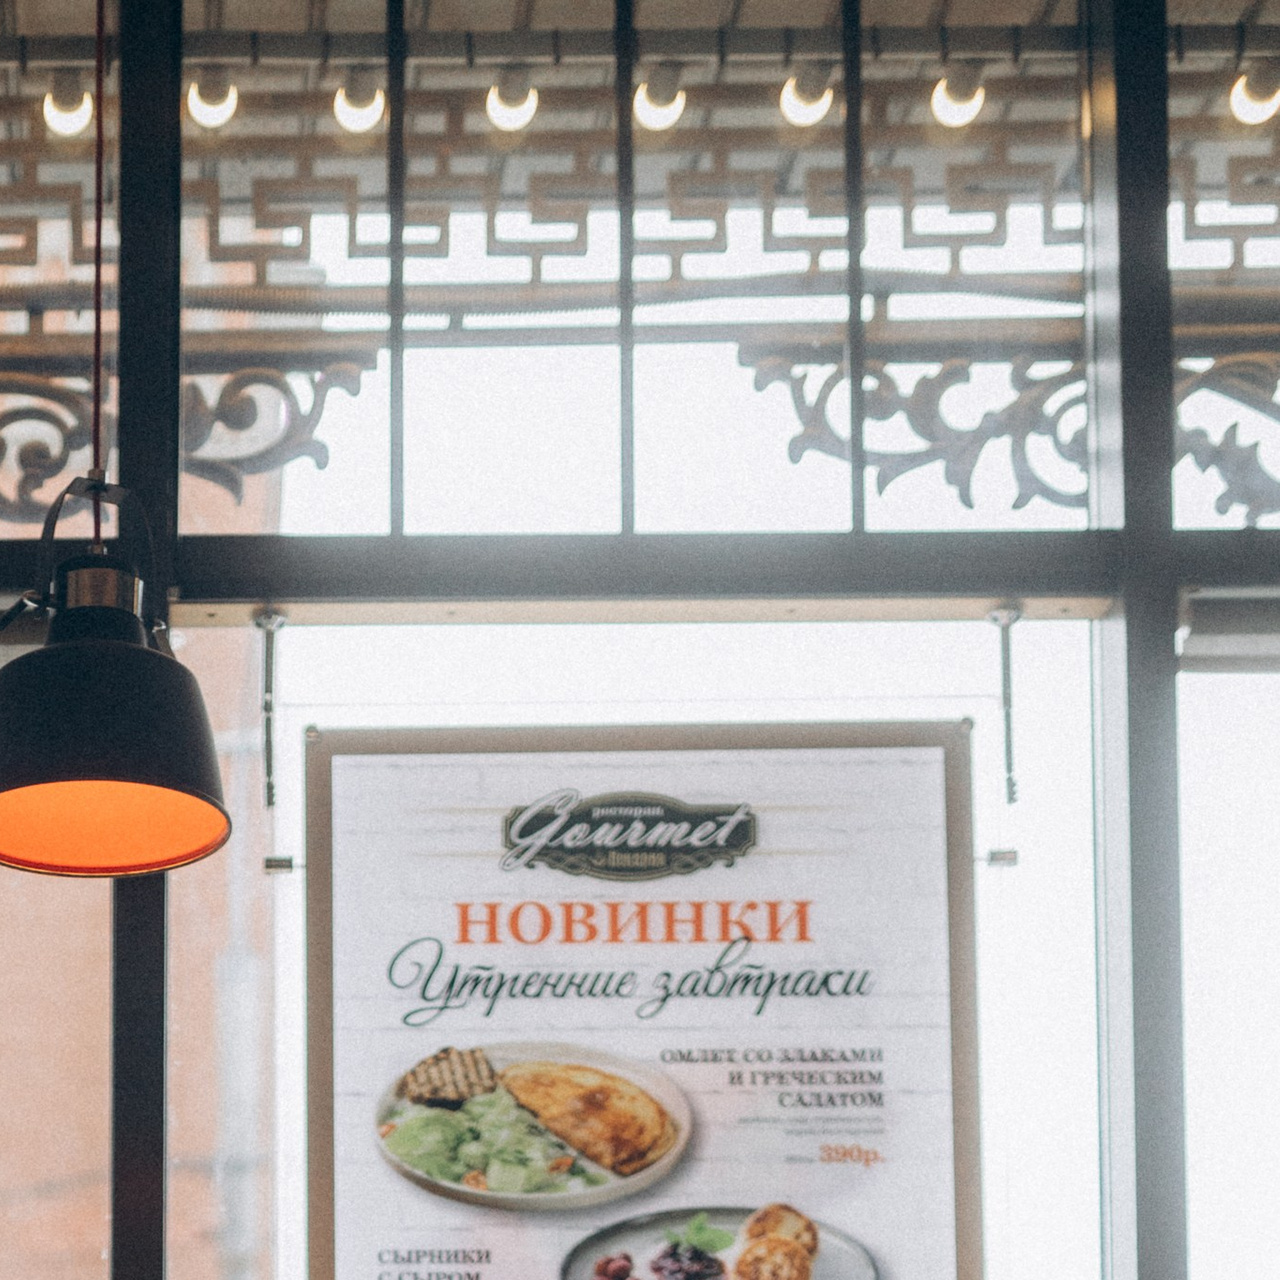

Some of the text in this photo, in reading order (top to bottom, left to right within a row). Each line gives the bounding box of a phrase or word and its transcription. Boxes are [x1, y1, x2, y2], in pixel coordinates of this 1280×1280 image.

[499, 788, 751, 870] Gourmet
[454, 900, 813, 944] НОВИНКИ
[387, 936, 874, 1026] Утренние завтраки
[660, 1048, 884, 1063] ОМЛЕТ СО ЗЛАКАМИ
[729, 1070, 884, 1085] И ГРЕЧЕСКИМ
[778, 1092, 884, 1108] САЛАТОМ
[378, 1249, 491, 1264] СЫРНИКИ
